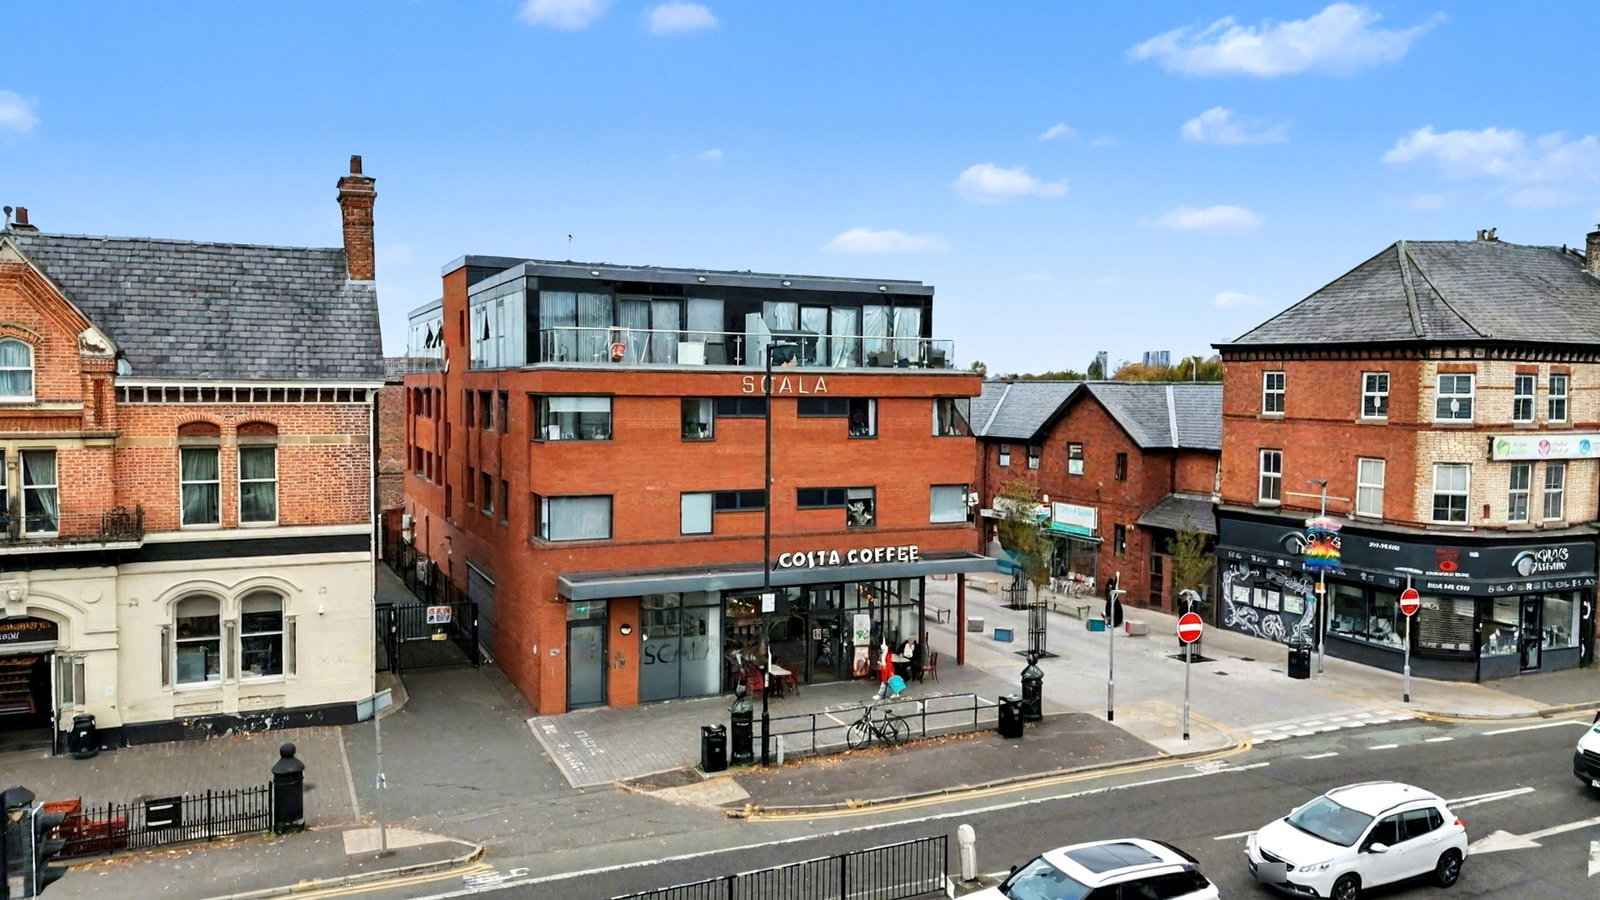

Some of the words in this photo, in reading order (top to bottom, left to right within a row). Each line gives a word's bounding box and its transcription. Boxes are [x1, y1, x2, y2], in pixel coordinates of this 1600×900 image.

[742, 375, 828, 394] SCALA
[779, 549, 840, 569] COSTA
[847, 545, 919, 565] COFFEE
